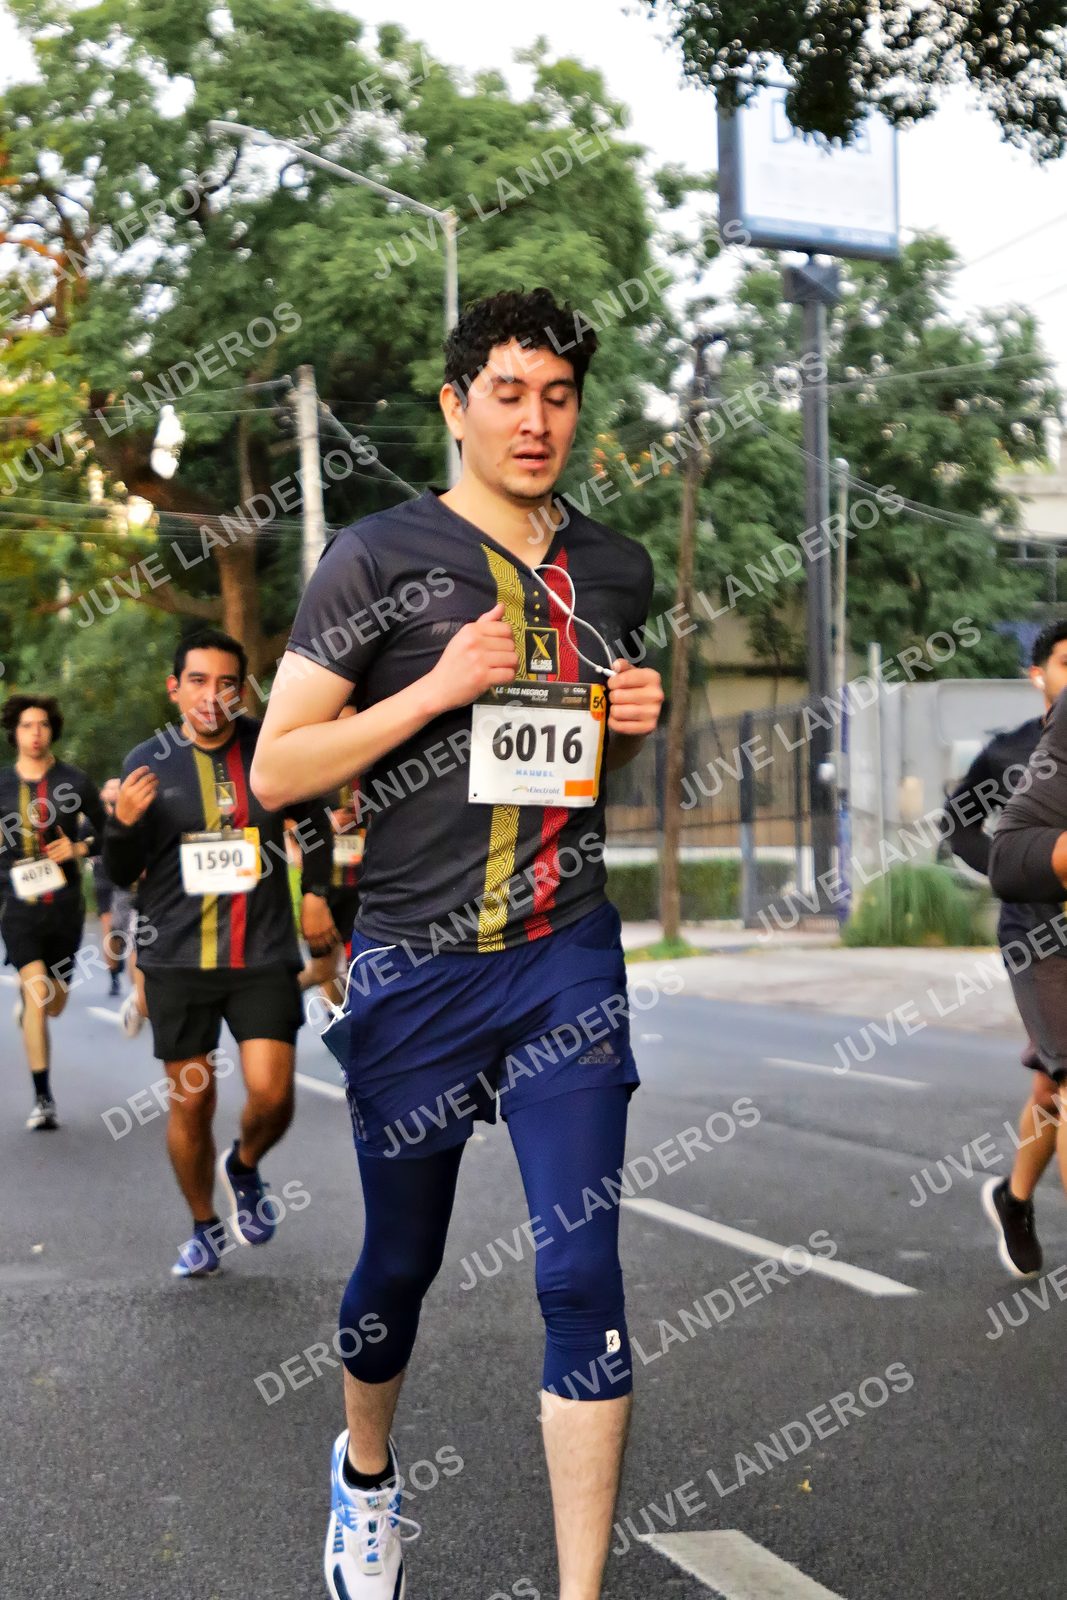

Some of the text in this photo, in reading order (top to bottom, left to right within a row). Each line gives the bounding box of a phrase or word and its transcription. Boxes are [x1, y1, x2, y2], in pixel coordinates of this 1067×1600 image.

[492, 722, 583, 764] 6016
[194, 848, 243, 871] 1590
[578, 1055, 620, 1066] adidas
